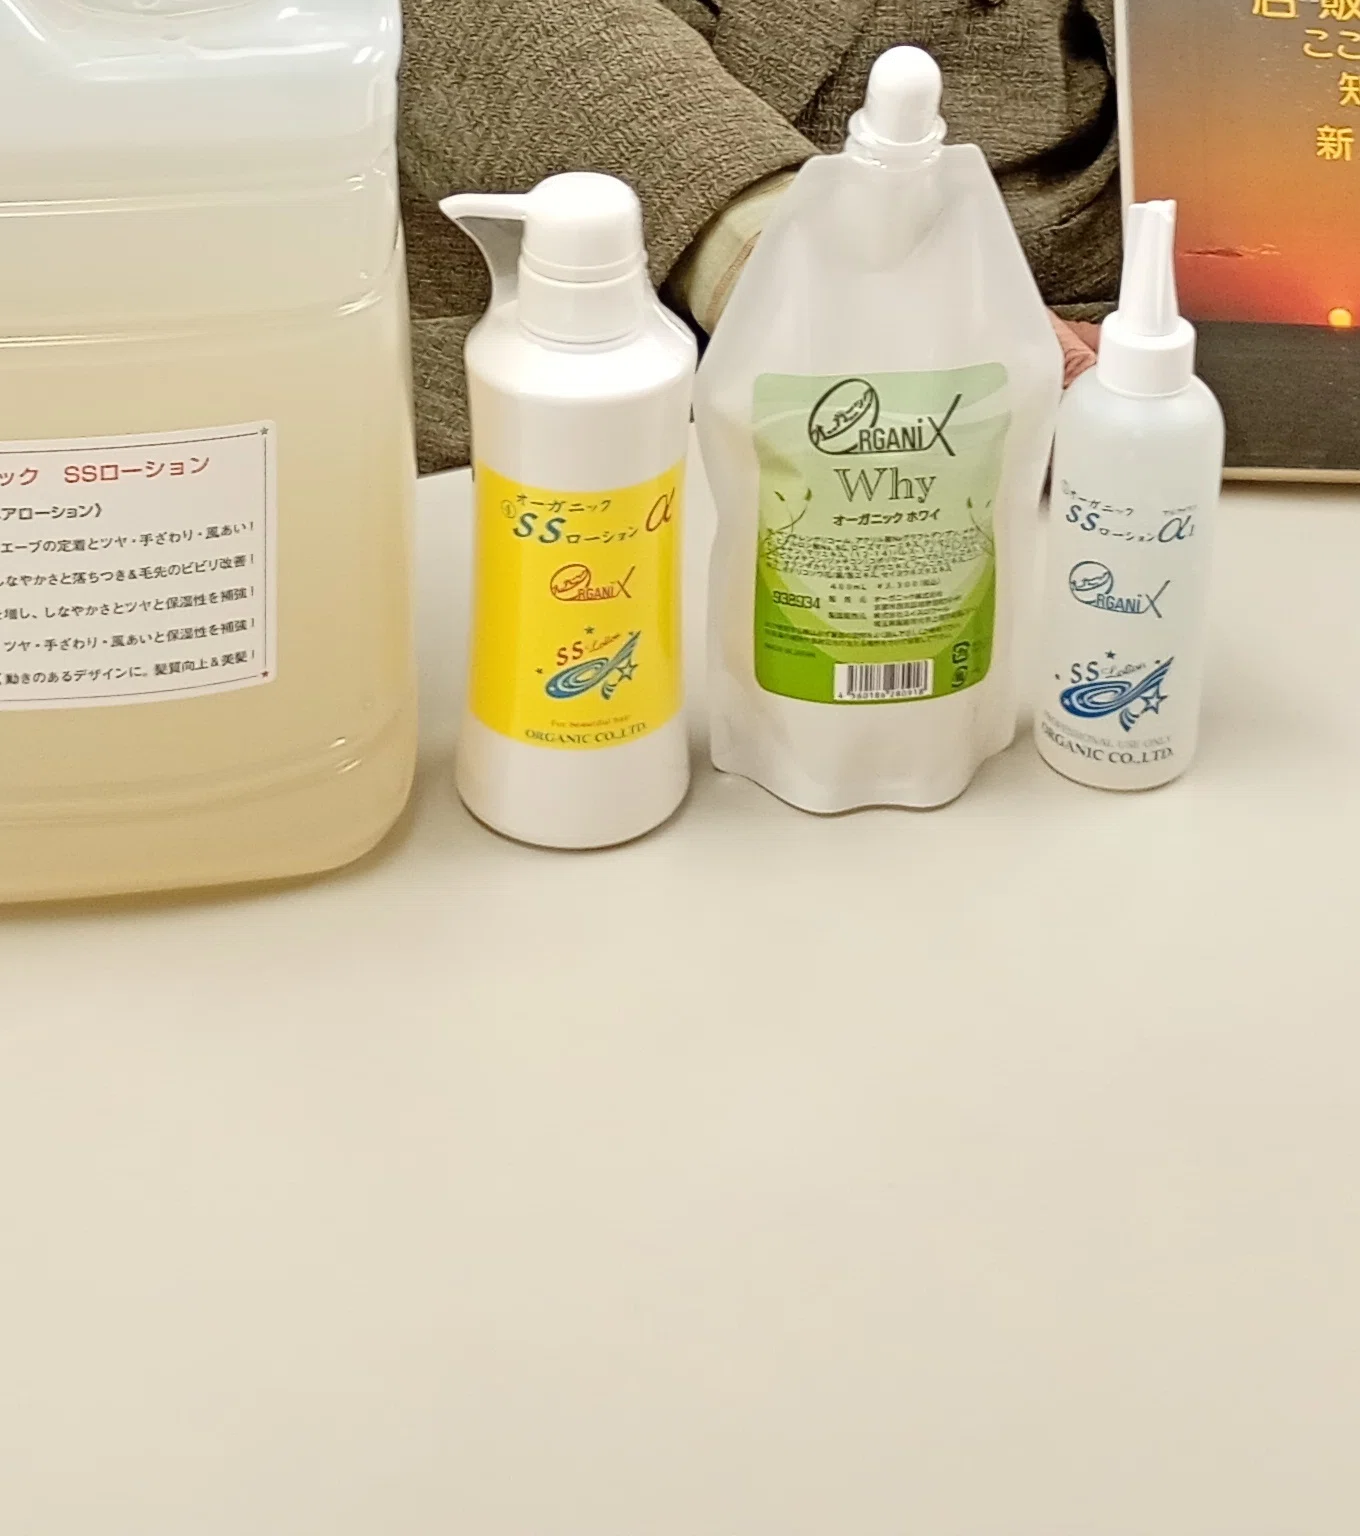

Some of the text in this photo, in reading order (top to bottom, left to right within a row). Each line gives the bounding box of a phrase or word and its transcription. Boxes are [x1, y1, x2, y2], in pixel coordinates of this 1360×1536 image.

[64, 456, 210, 485] SSローション
[833, 466, 938, 503] Why
[517, 493, 612, 513] オーガニック
[833, 508, 940, 526] オーガニック ホワイ
[557, 641, 584, 666] SS
[1070, 661, 1099, 684] SS
[524, 727, 590, 745] ORGANIC
[1041, 721, 1105, 761] ORGANIC
